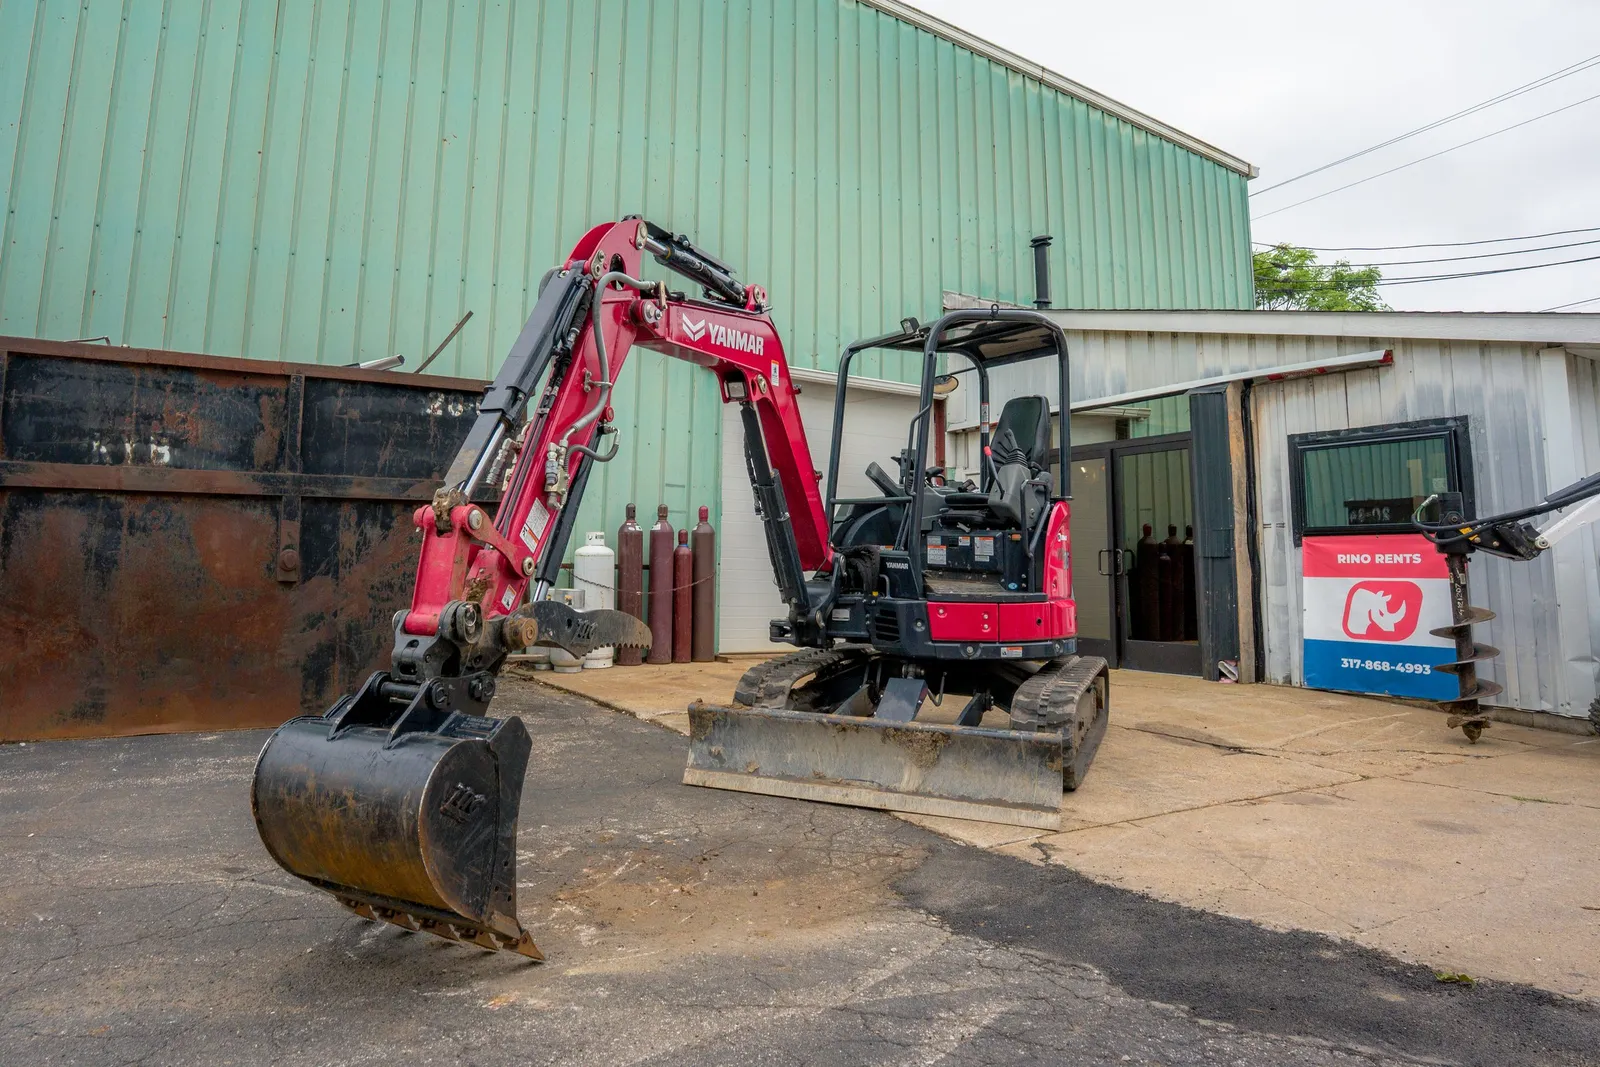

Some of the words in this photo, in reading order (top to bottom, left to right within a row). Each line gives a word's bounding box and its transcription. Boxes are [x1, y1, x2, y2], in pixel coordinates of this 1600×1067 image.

[708, 322, 764, 356] YANMAR
[885, 561, 909, 570] YANMAR
[1337, 553, 1372, 564] RINO
[1375, 553, 1422, 564] RENTS
[1341, 658, 1431, 675] 317-868-4993
